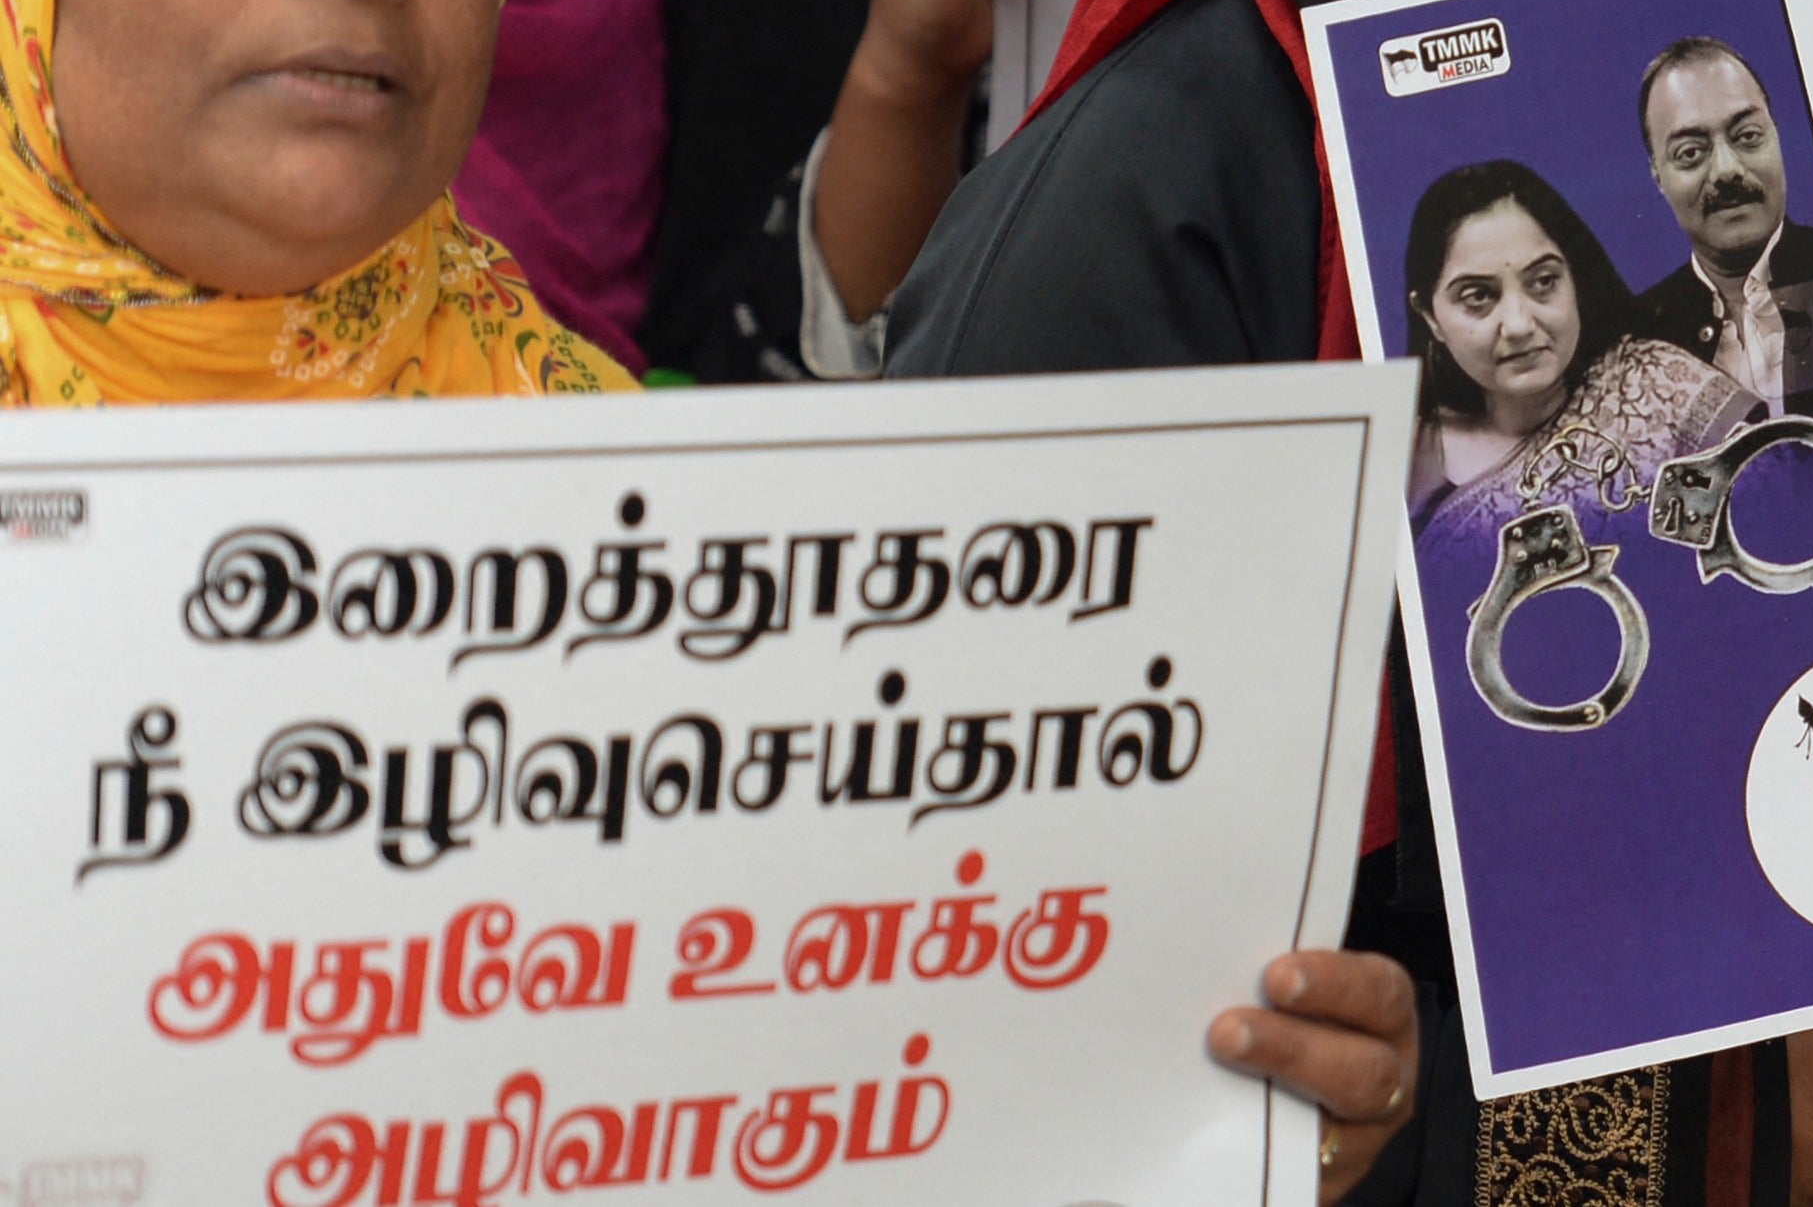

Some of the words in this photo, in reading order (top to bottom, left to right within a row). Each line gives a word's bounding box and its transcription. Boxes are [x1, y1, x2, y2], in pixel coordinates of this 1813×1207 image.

[1422, 27, 1498, 62] TMMK
[1442, 57, 1490, 80] MEDIA
[182, 491, 1156, 674] இறைத்தூதரை
[76, 702, 192, 887] நீ
[236, 654, 1206, 871] இழிவுசெய்தால்
[146, 900, 639, 1068] அதுவே
[668, 848, 1112, 1004] உனக்கு
[265, 1032, 954, 1207] அழிவாகும்
